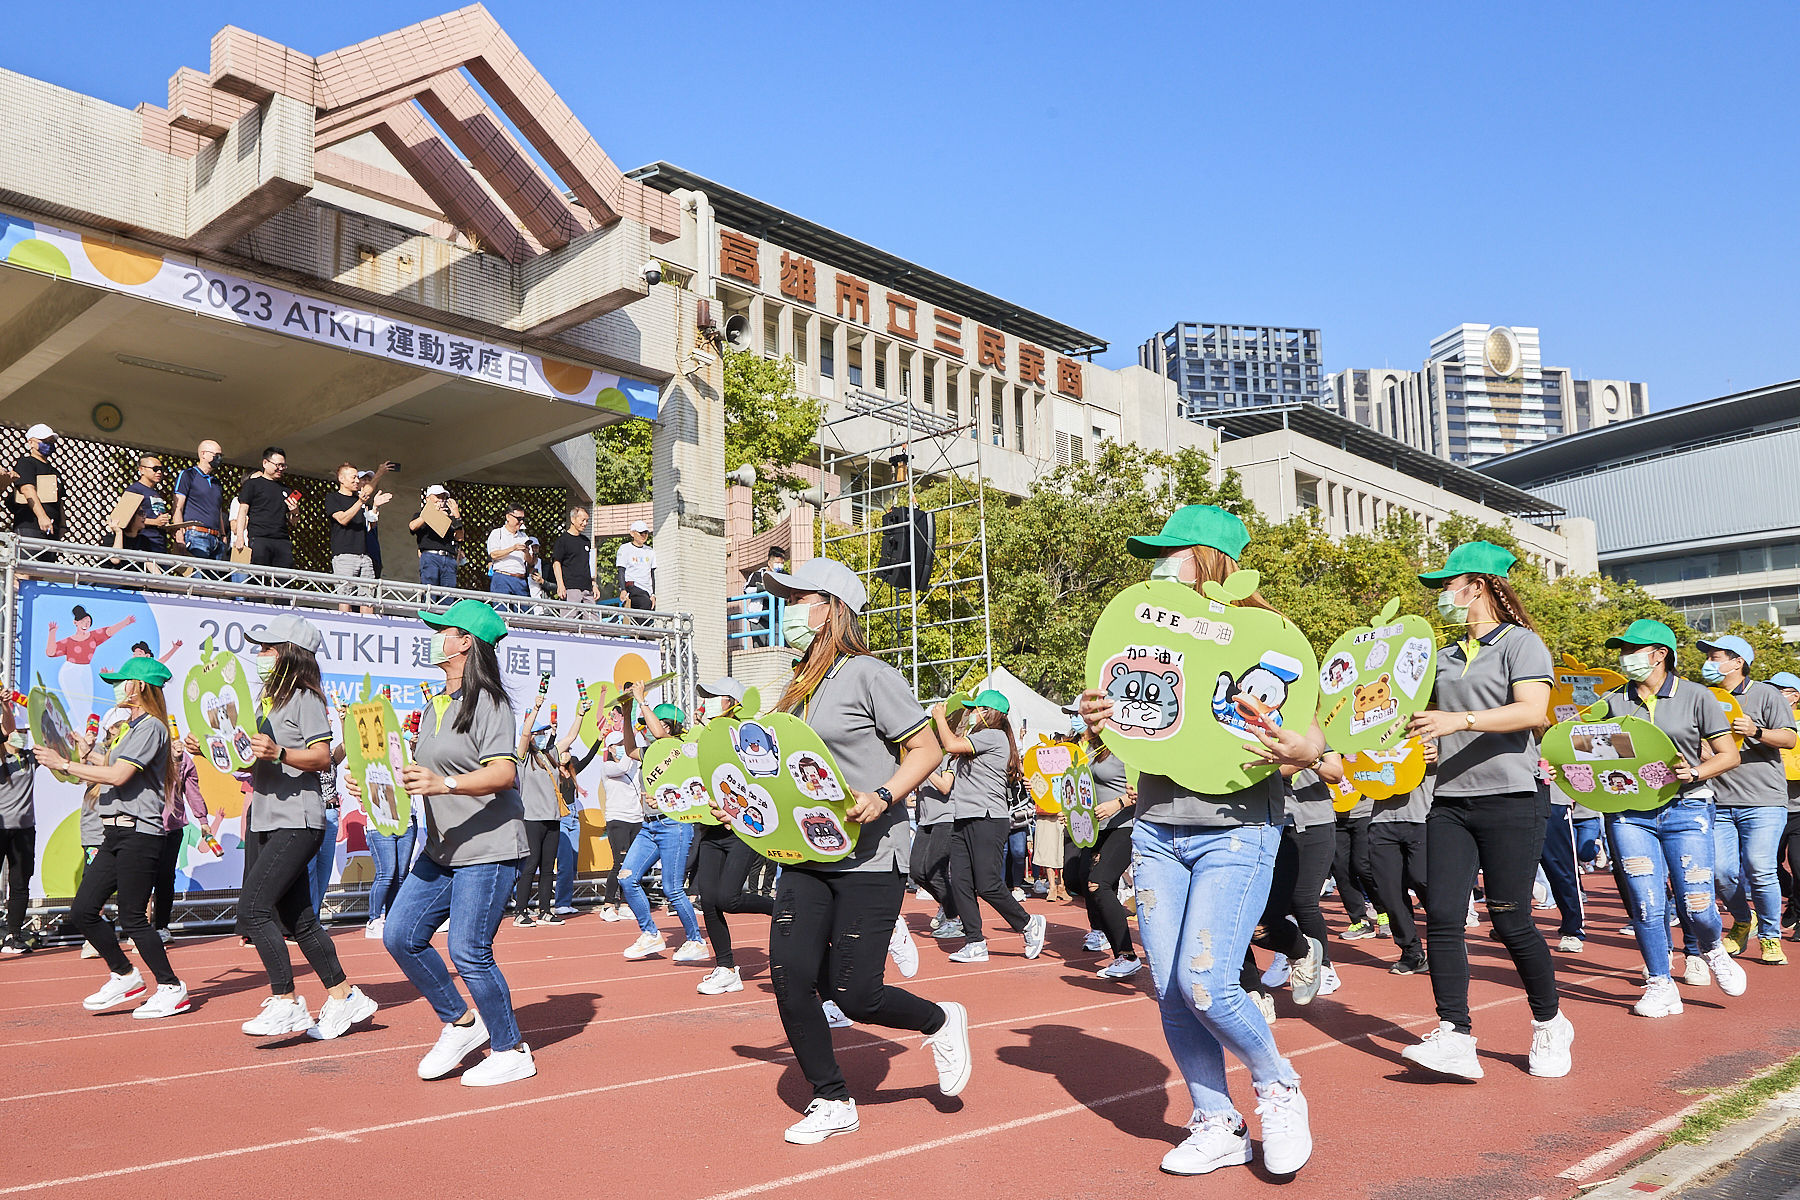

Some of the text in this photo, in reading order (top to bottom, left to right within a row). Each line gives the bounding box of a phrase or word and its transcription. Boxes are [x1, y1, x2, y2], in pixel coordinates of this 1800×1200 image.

[182, 272, 529, 386] 2023 ATKH 運動家庭日
[720, 229, 1083, 399] 高雄市立三民家商
[1141, 607, 1232, 641] AFE 加油
[1354, 632, 1376, 643] AFE
[199, 620, 267, 655] 20
[412, 636, 555, 677] 運庭日
[646, 766, 664, 786] AFE
[767, 850, 783, 858] AFE
